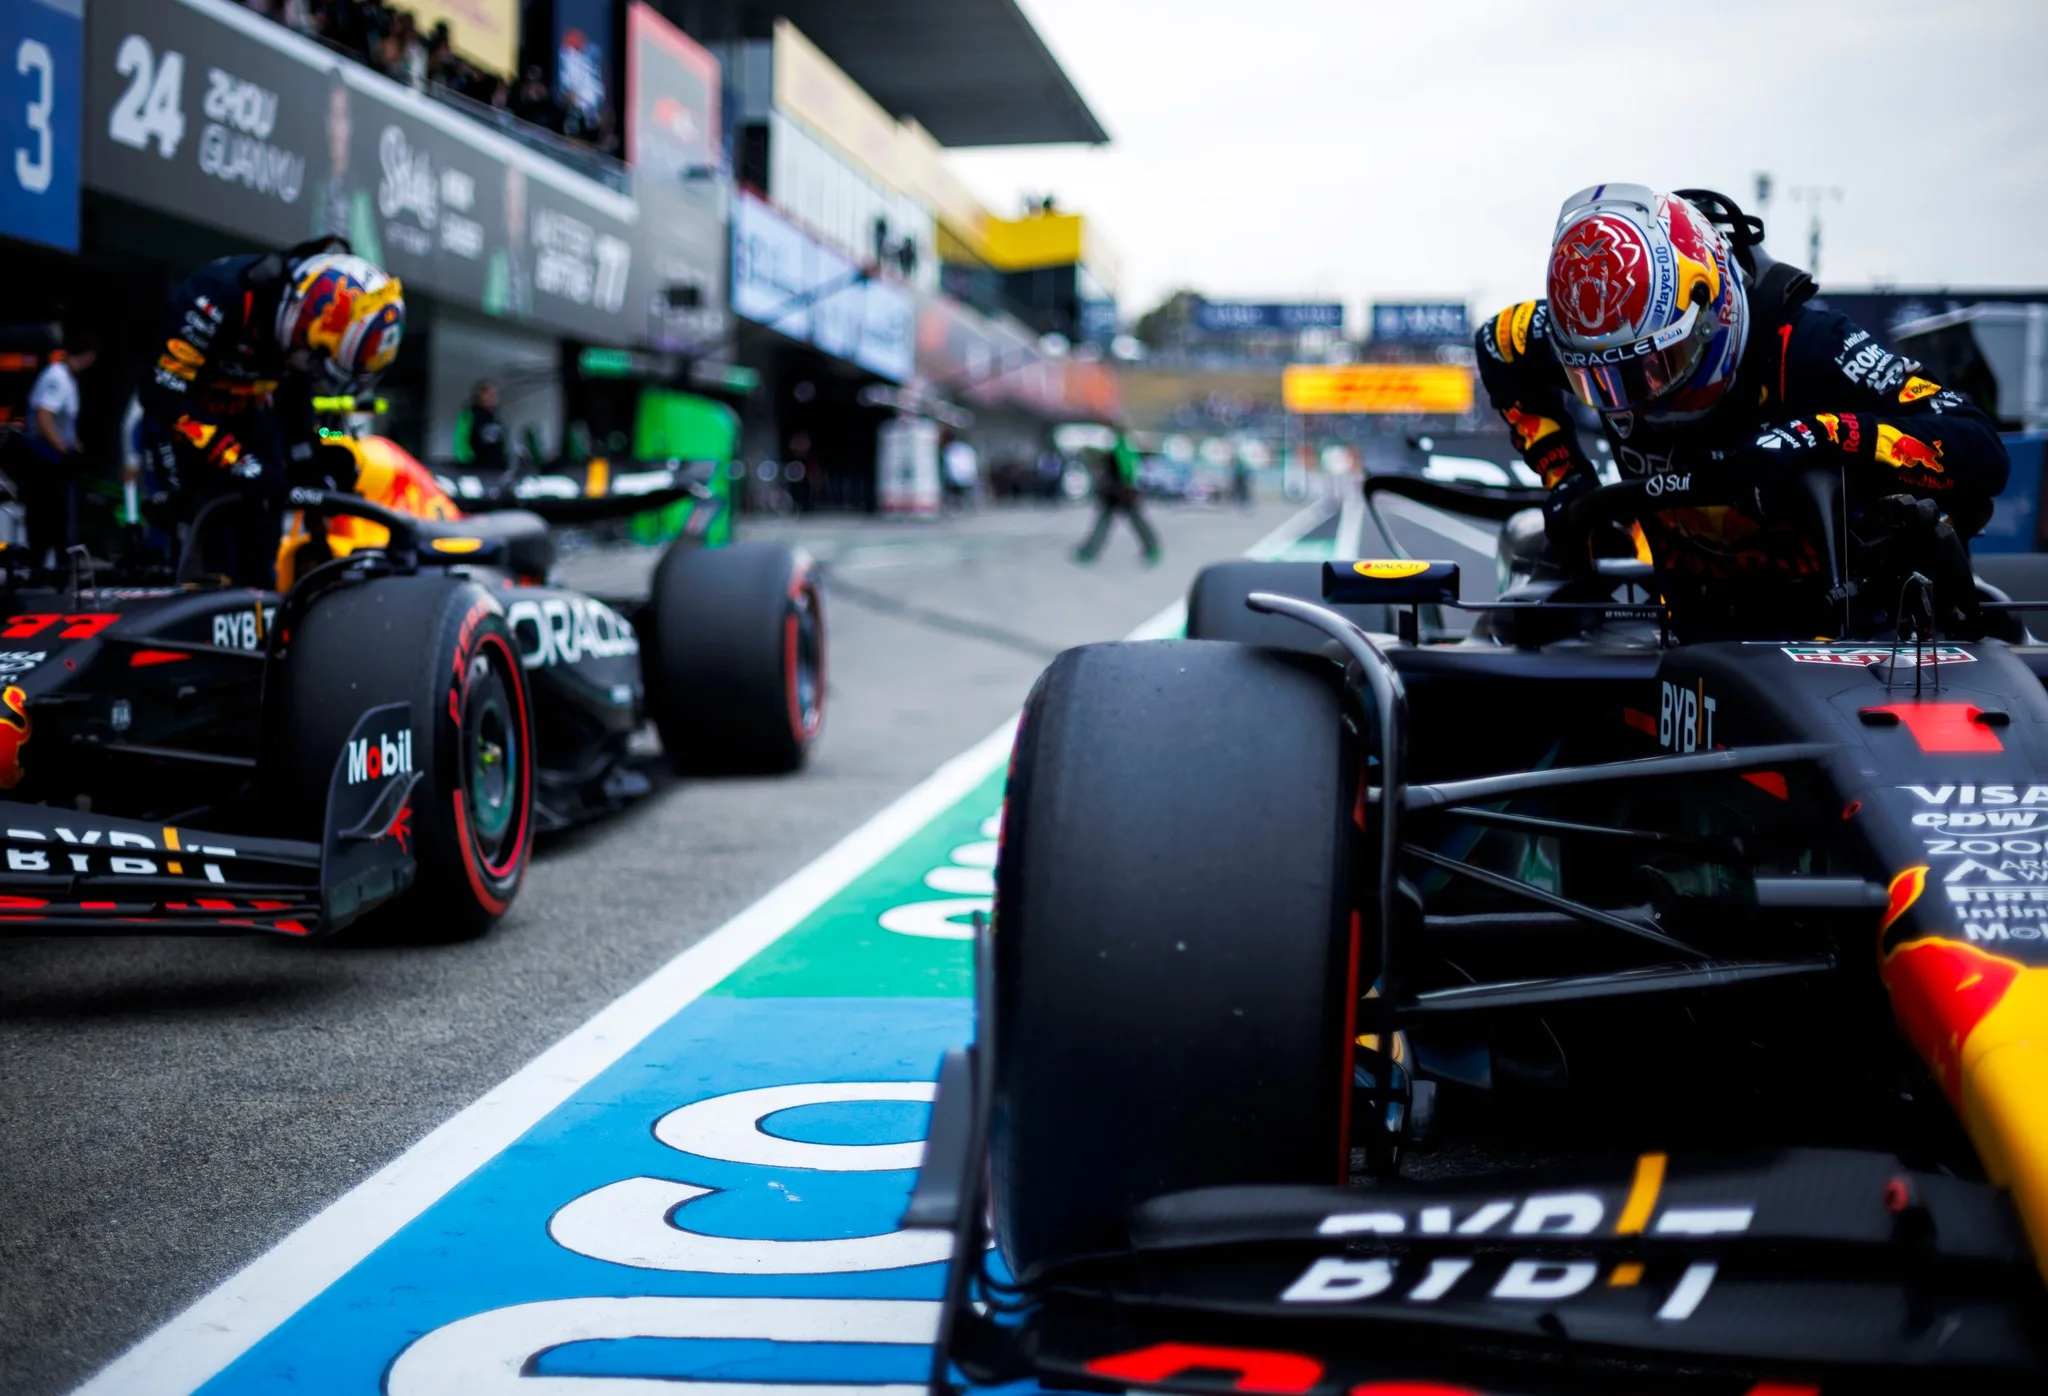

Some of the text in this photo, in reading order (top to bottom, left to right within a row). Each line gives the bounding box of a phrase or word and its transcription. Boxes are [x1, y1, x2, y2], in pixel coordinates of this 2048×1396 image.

[15, 38, 53, 194] 3
[108, 34, 186, 160] 24
[1653, 266, 1673, 316] Player
[1564, 339, 1652, 367] ORACLE
[1665, 473, 1692, 491] Sui
[1660, 677, 1716, 754] BYBIT
[347, 728, 413, 785] Mobil
[1911, 812, 2039, 827] CDW
